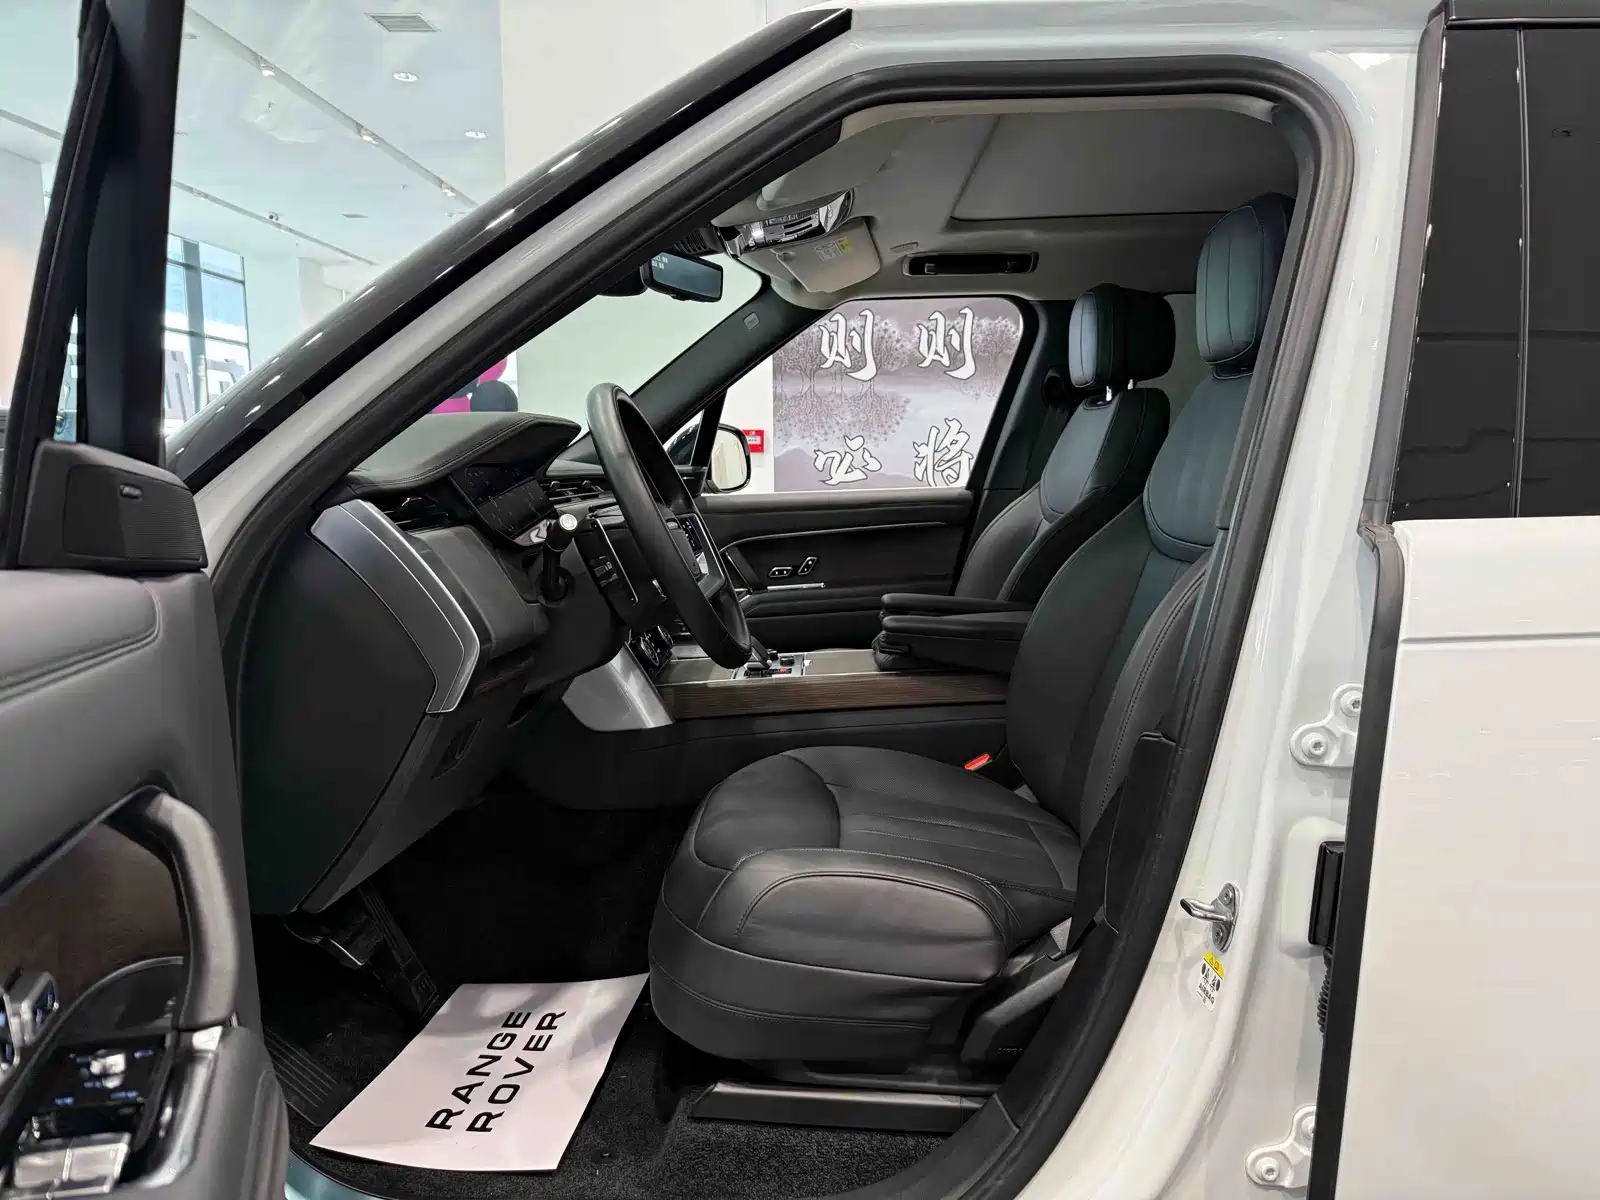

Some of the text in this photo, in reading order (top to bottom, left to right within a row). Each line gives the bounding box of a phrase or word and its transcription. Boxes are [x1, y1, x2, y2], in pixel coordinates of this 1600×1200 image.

[1198, 983, 1215, 1004] AIRBAG
[425, 1011, 532, 1130] RANGE
[465, 1010, 567, 1133] ROVER
